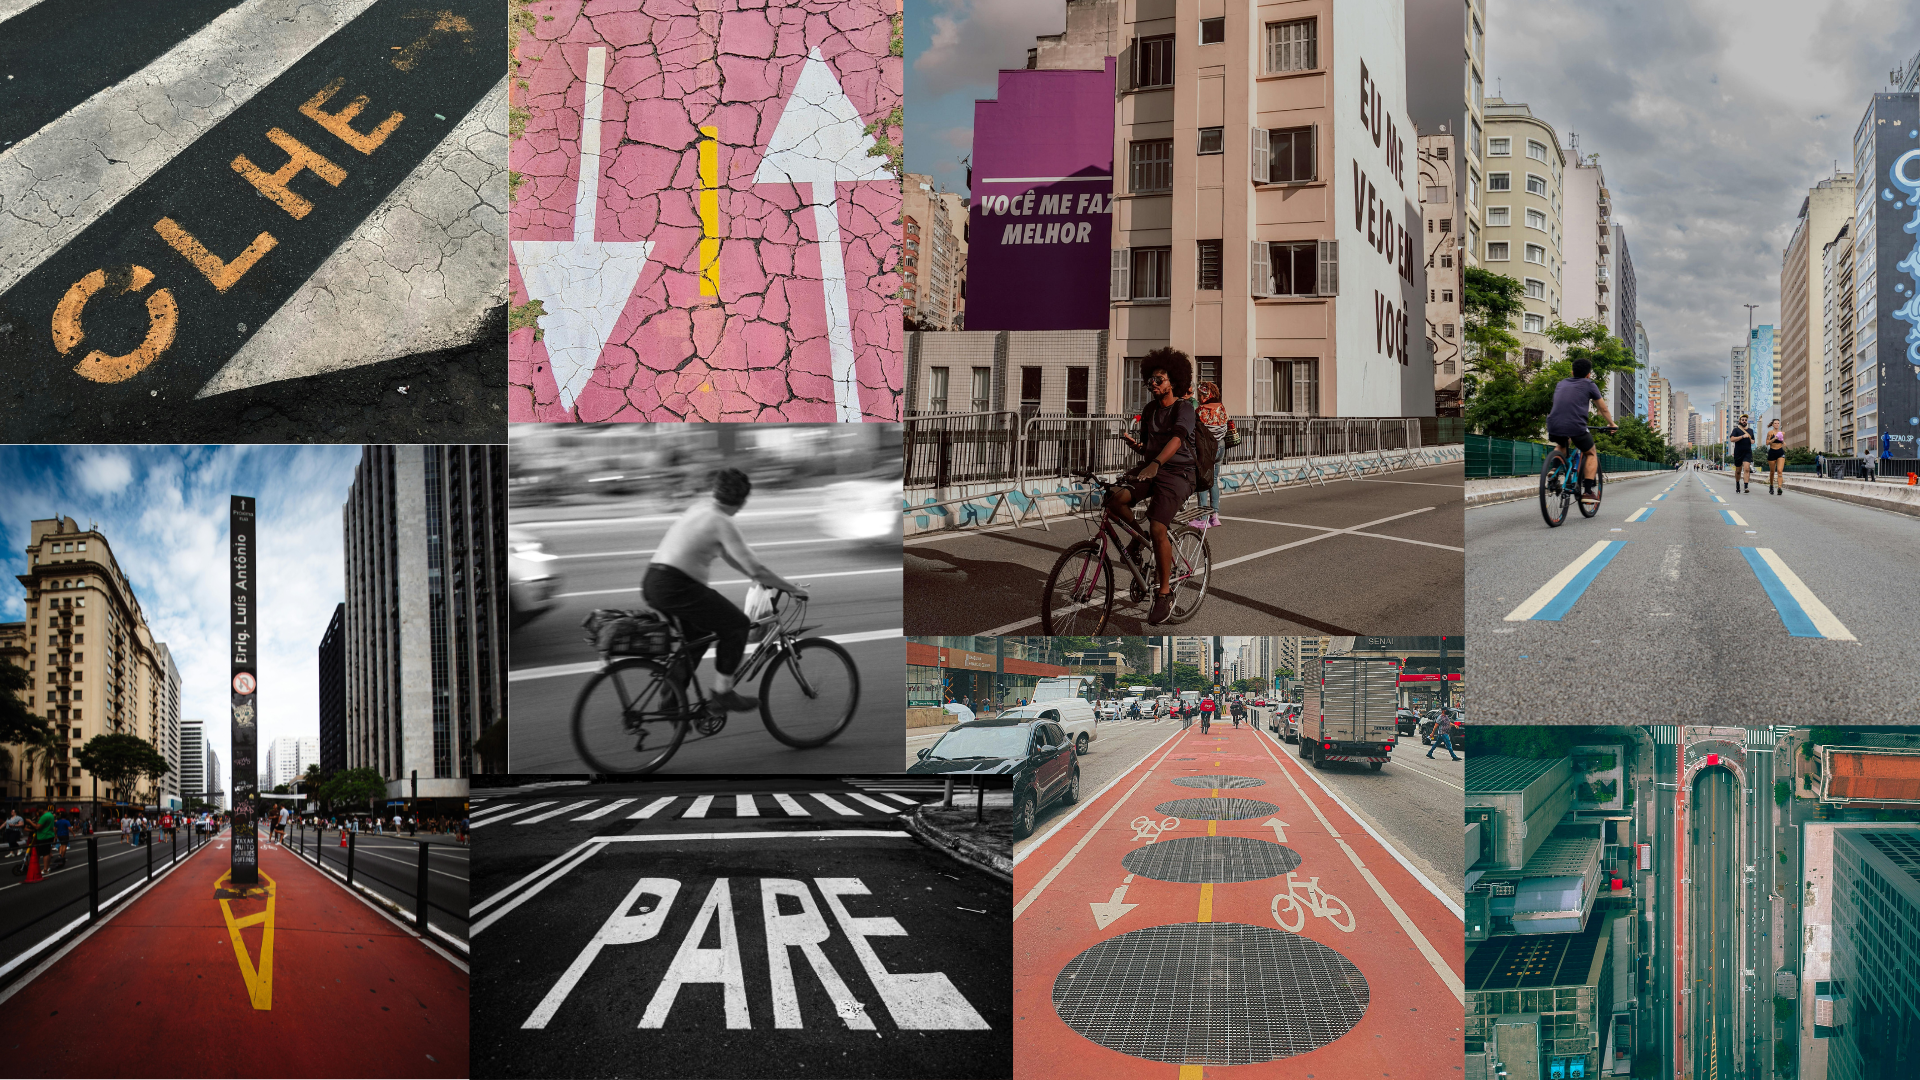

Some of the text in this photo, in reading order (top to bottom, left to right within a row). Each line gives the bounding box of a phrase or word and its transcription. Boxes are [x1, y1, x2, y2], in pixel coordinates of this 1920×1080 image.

[1360, 55, 1404, 192] EU ME
[51, 77, 406, 385] OLHE
[981, 189, 1114, 216] VOCÊ ME FAZ
[1001, 221, 1092, 245] MELHOR
[1352, 157, 1415, 288] VEJO EM
[1374, 288, 1409, 367] VOCÊ
[232, 534, 251, 664] Brig. Luís Antônio
[1368, 637, 1394, 645] SENAI
[520, 877, 993, 1031] PARE
